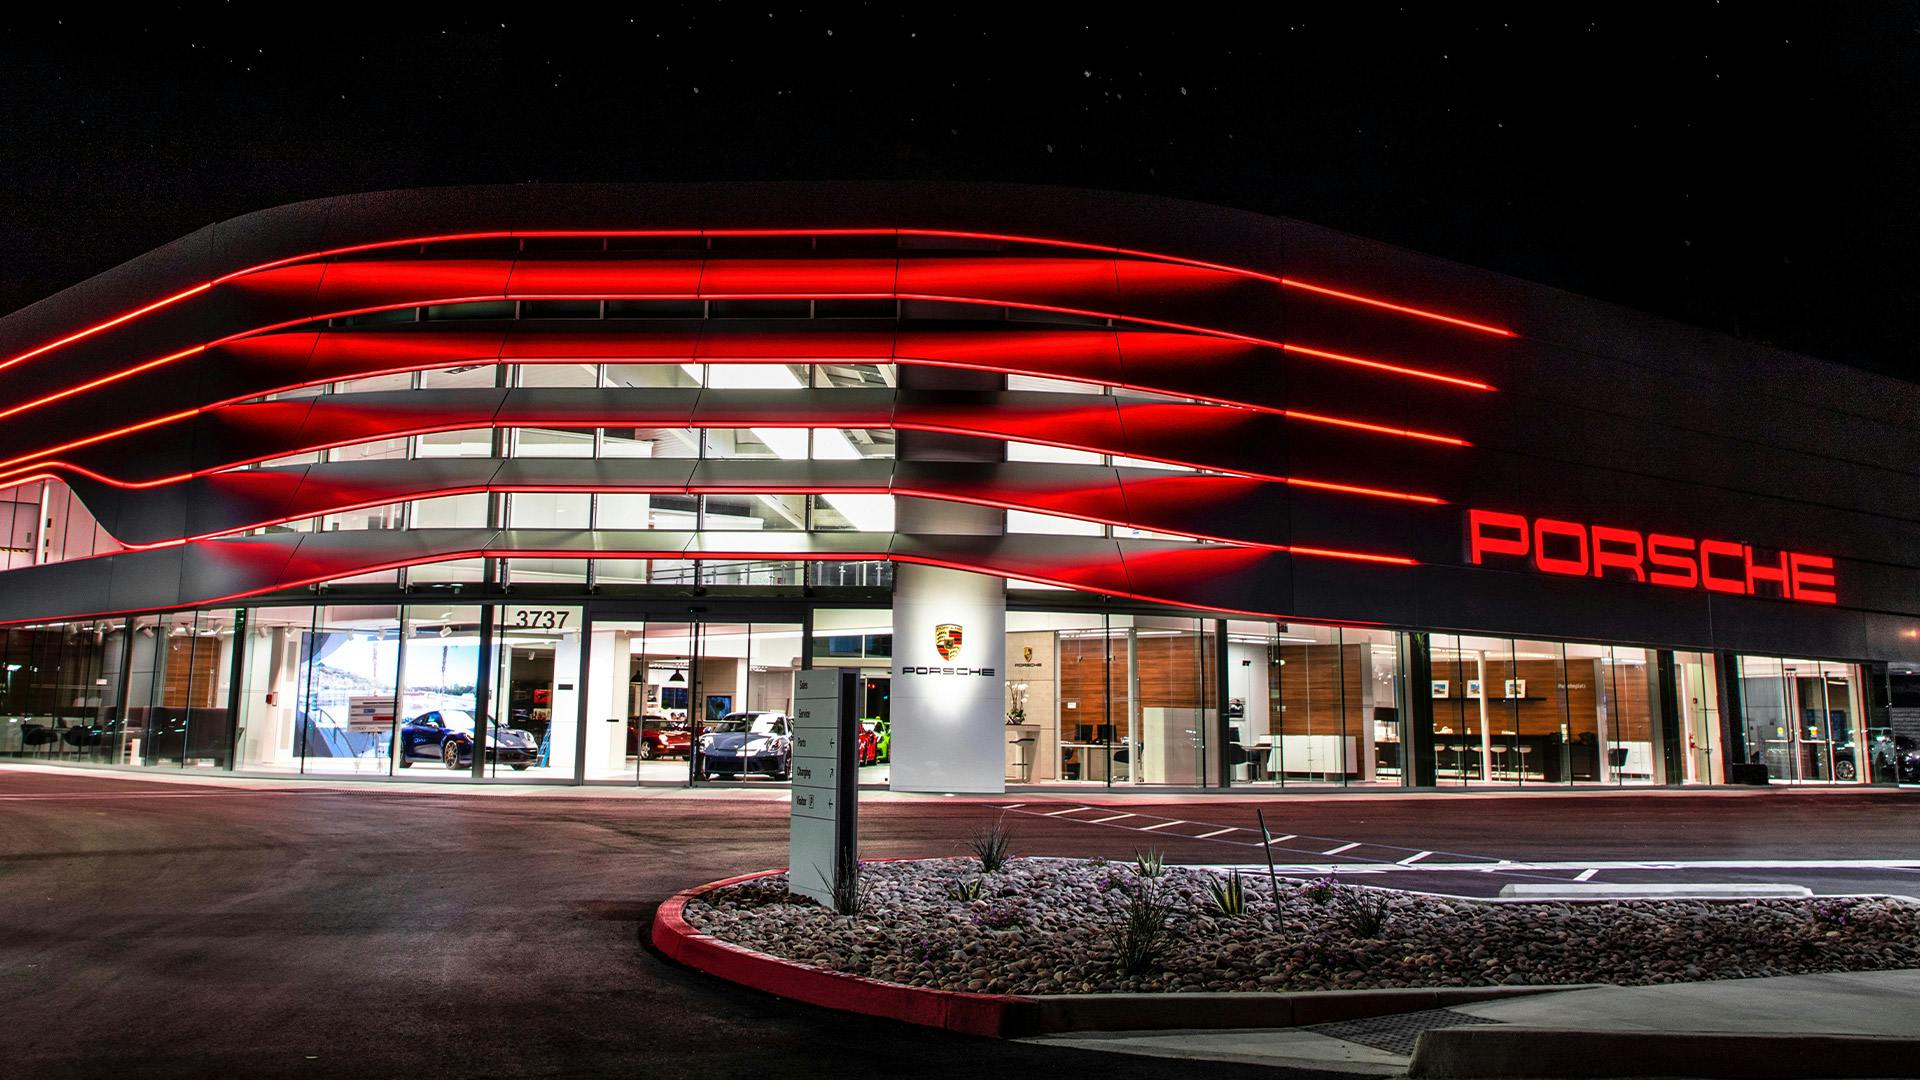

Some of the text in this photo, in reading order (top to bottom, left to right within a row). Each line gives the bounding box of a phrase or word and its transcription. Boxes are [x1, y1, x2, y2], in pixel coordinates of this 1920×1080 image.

[1470, 509, 1837, 604] PORSCHE
[516, 610, 570, 629] 3737
[902, 667, 995, 676] PORSCHE
[799, 708, 810, 718] Service
[798, 738, 806, 747] Parts
[797, 767, 811, 779] Charging
[797, 796, 806, 806] Visitor
